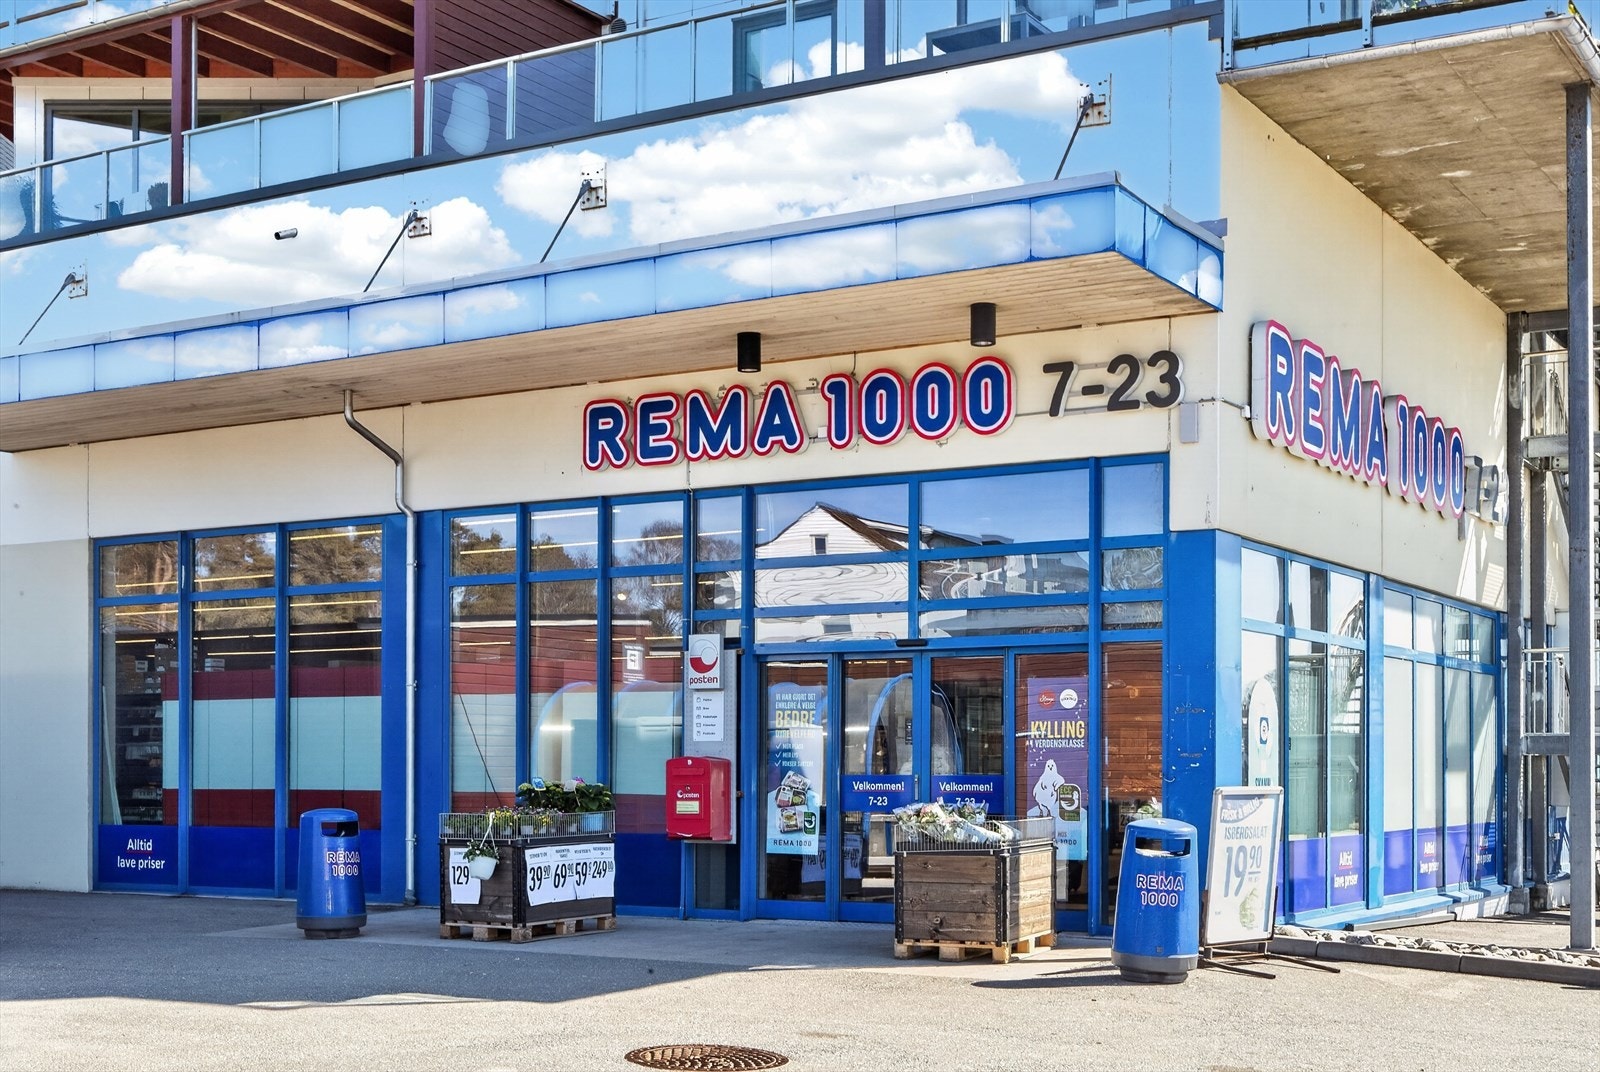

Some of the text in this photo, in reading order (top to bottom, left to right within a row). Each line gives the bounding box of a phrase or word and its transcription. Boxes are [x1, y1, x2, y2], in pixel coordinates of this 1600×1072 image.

[1042, 350, 1184, 418] 7-23
[582, 356, 1014, 472] REMA 1000
[1264, 319, 1465, 519] REMA 1000
[689, 675, 718, 687] posten
[775, 710, 816, 728] BEDRE
[1031, 720, 1085, 739] KYLLING
[1035, 739, 1085, 748] VERDENSKLASSE
[852, 781, 905, 791] Velkommen!
[939, 781, 993, 792] Velkommen!
[868, 796, 888, 806] 7-23
[1224, 826, 1268, 840] ISBERGSALAT
[126, 838, 153, 851] Alltid
[773, 839, 812, 848] REMA 1000
[117, 856, 166, 871] lave priser
[326, 851, 360, 864] REMA
[1339, 851, 1353, 866] Alltid
[332, 864, 359, 876] 1000
[451, 865, 470, 885] 129
[553, 863, 567, 888] 69
[575, 862, 588, 887] 59
[592, 860, 607, 878] 249
[1223, 845, 1263, 897] 19 90
[529, 865, 551, 892] 39 90
[1136, 874, 1185, 891] REMA
[1334, 871, 1359, 890] lave priser
[1140, 891, 1179, 907] 1000
